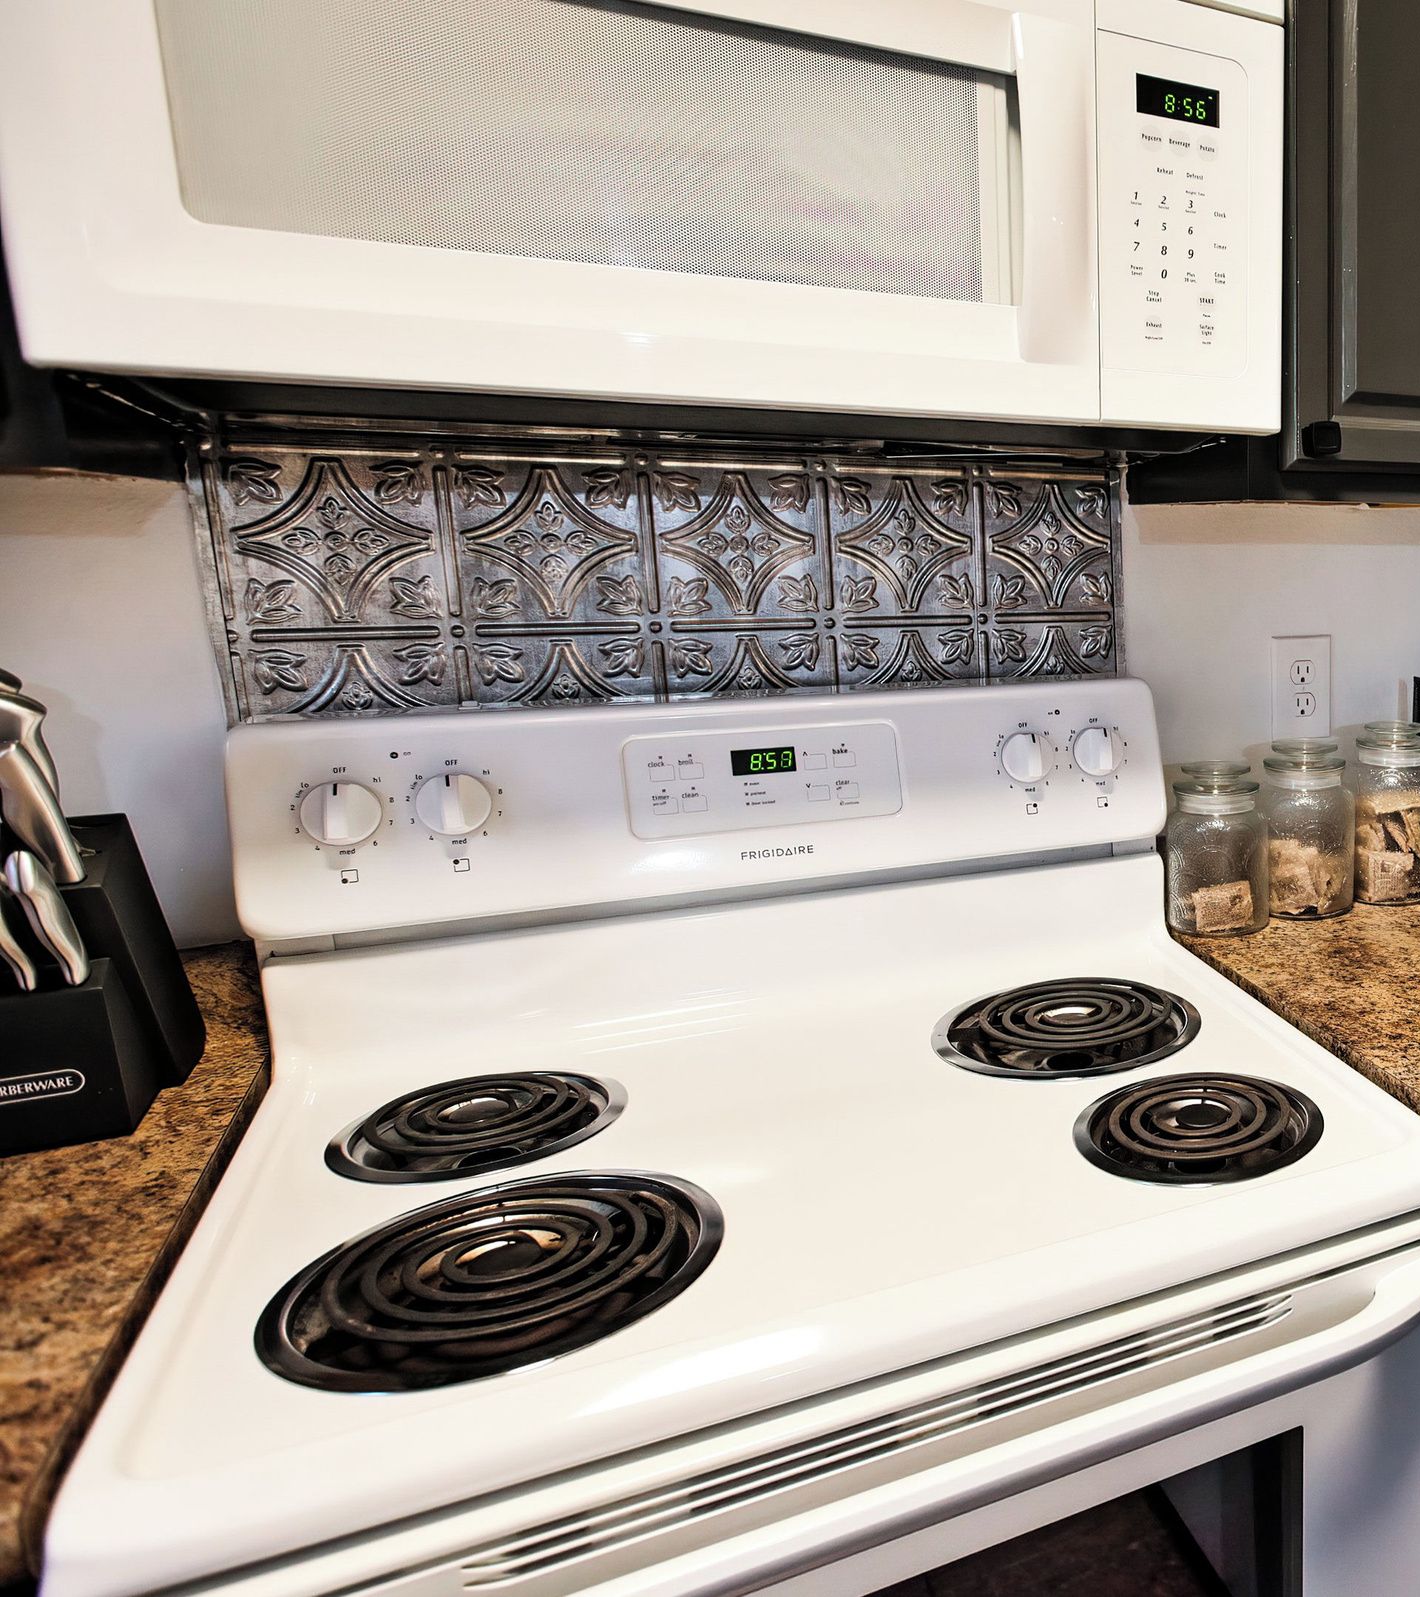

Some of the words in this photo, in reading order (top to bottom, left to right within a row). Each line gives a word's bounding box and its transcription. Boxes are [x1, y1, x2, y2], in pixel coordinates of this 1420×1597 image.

[1165, 94, 1206, 119] 8:56
[1141, 133, 1162, 142] Popcorn
[1169, 138, 1191, 148] Beverage
[1199, 145, 1215, 153] Potato
[1157, 167, 1174, 175] Reheat
[1186, 172, 1204, 180] Defrost
[1134, 191, 1138, 200] 1
[1160, 196, 1167, 205] 2
[1188, 200, 1193, 209] 3
[1134, 219, 1140, 227] 4
[1161, 222, 1167, 231] 5
[1188, 227, 1193, 235] 6
[1134, 241, 1140, 251] 7
[1160, 246, 1168, 255] 8
[1188, 249, 1194, 259] 9
[1161, 269, 1168, 279] 0
[333, 766, 347, 774] OFF
[740, 844, 814, 861] FRIGIDAIRE
